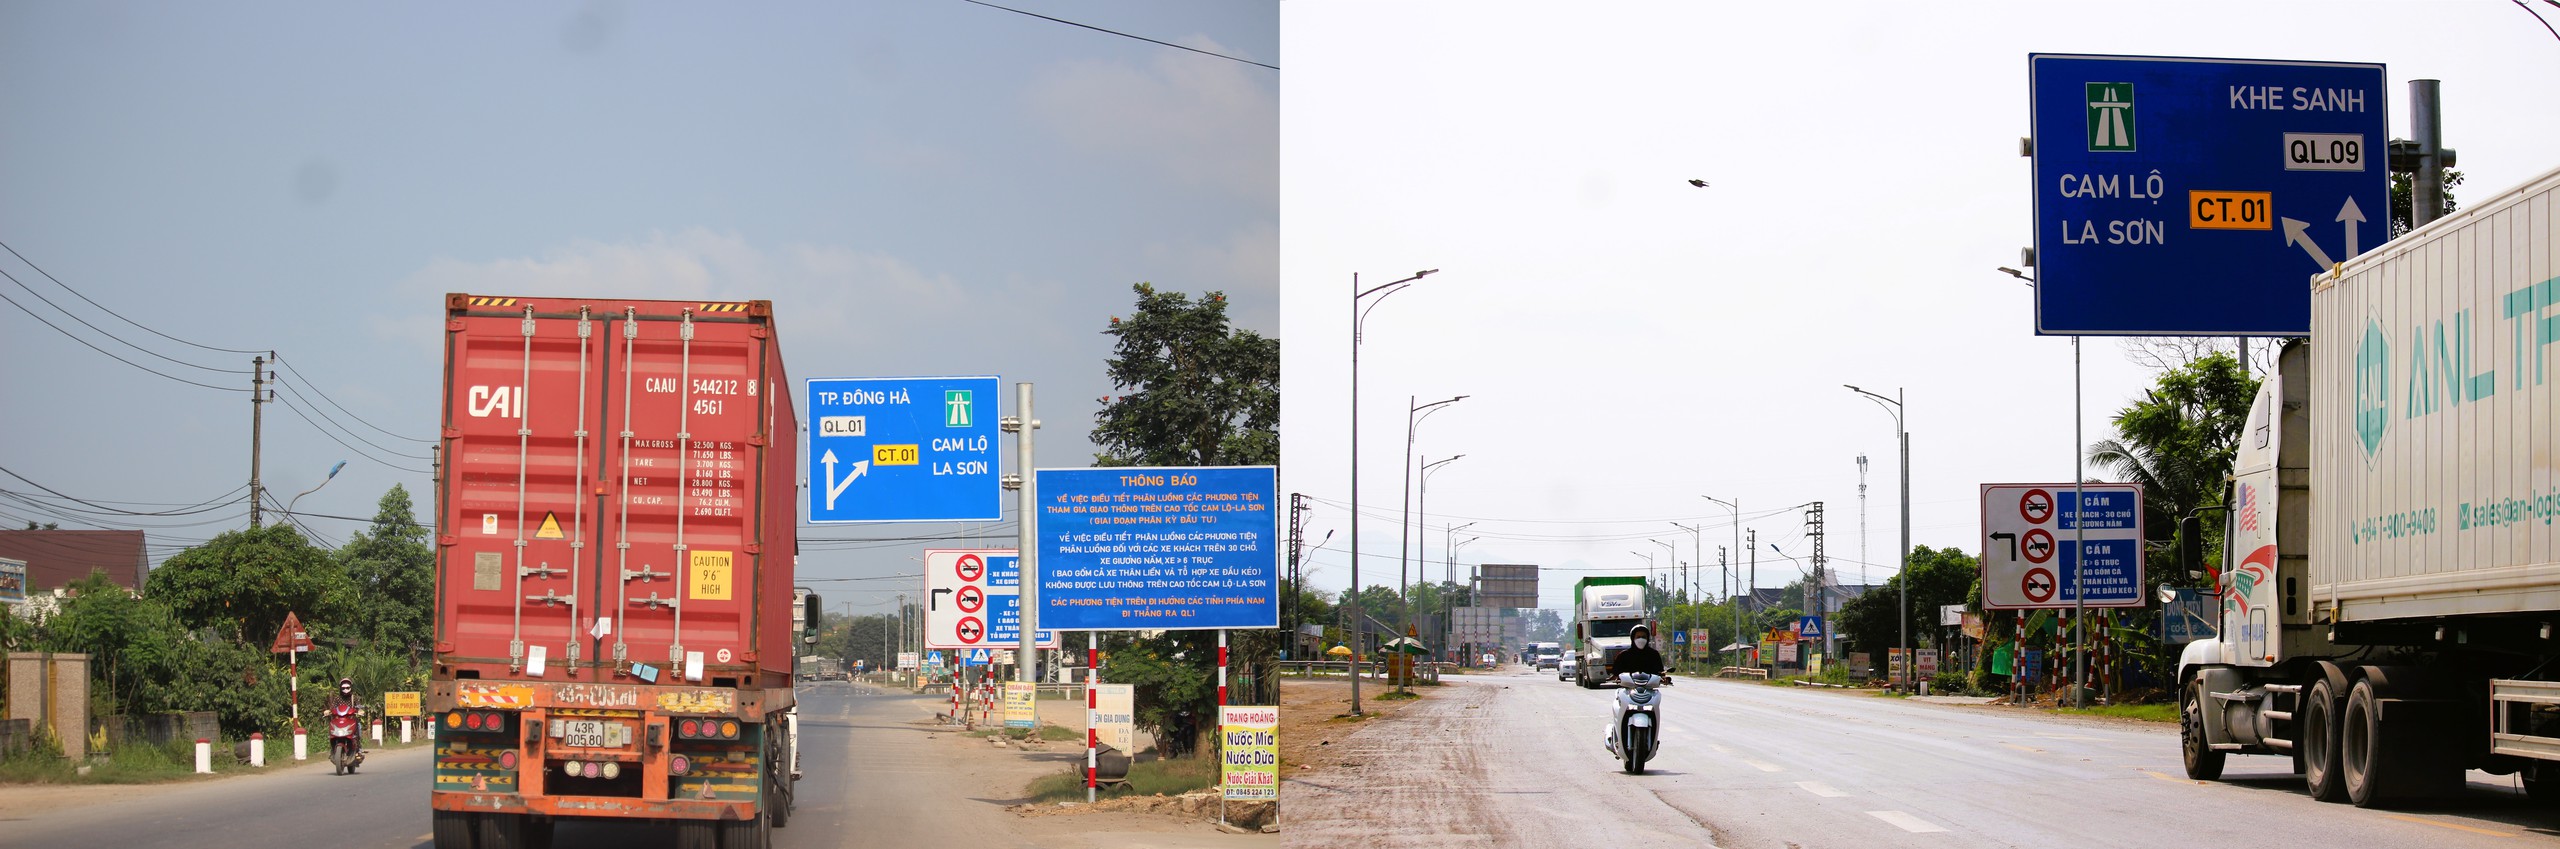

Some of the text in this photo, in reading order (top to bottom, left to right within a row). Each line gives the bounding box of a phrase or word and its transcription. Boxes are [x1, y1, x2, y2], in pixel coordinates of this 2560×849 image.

[2230, 85, 2365, 113] KHE SANH
[2291, 140, 2359, 165] QL.09
[2060, 168, 2164, 205] CAM LỘ
[2197, 198, 2265, 223] CT.01
[2063, 218, 2164, 245] LA SƠN
[2406, 307, 2495, 420] ANL
[645, 377, 738, 395] CAAU 544212
[2358, 362, 2386, 415] ANL
[468, 385, 522, 419] CAI
[819, 387, 911, 405] TP. ĐÔNG HÀ
[693, 399, 722, 415] 45G1
[824, 420, 863, 434] QL.01
[635, 440, 734, 450] MAX GROSS 32.500 KGS.
[932, 435, 988, 454] CAM LỘ
[693, 451, 734, 459] 71.650 LBS.
[877, 449, 915, 462] CT.01
[635, 459, 733, 469] TARE 3.700 KGS.
[933, 460, 988, 475] LA SƠN
[695, 470, 733, 478] 8.160 LBS.
[1120, 472, 1197, 487] THÔNG BÁO
[634, 477, 733, 488] NET 28.800 KGS.
[692, 489, 733, 498] 63.490 LBS.
[1071, 494, 1088, 504] VIỆC
[1133, 494, 1156, 502] PHÂN
[1186, 492, 1203, 501] CÁC
[1205, 493, 1238, 501] PHƯƠNG
[1241, 492, 1259, 502] TIỆN
[647, 497, 663, 505] CAP.
[2084, 494, 2110, 507] CẤM
[694, 508, 712, 516] 2.690
[1090, 505, 1109, 513] GIAO
[1111, 504, 1138, 512] THÔNG
[1140, 503, 1162, 512] TRÊN
[1164, 504, 1180, 512] CAO
[1201, 504, 1219, 512] CAM
[1114, 517, 1136, 526] ĐOẠN
[1139, 516, 1162, 524] PHÂN
[1073, 533, 1091, 543] VIỆC
[1135, 532, 1158, 541] PHÂN
[1188, 531, 1204, 540] CÁC
[1239, 531, 1257, 541] TIỆN
[1060, 544, 1082, 553] PHÂN
[1143, 543, 1158, 552] CÁC
[1173, 542, 1200, 552] KHÁCH
[1203, 543, 1226, 552] TRÊN
[1228, 544, 1238, 552] 30
[2085, 543, 2111, 555] CẤM
[693, 555, 730, 567] CAUTION
[1100, 557, 1110, 565] XE
[1192, 556, 1213, 565] TRỤC
[1106, 569, 1117, 577] XE
[1119, 568, 1141, 576] THÂN
[1209, 568, 1219, 576] XE
[701, 584, 720, 595] HIGH
[1045, 580, 1073, 589] KHÔNG
[1075, 581, 1096, 590] ĐƯỢC
[1099, 581, 1115, 589] LƯU
[1117, 580, 1144, 588] THÔNG
[1146, 579, 1168, 588] TRÊN
[1202, 580, 1220, 588] CAM
[1051, 597, 1067, 606] CÁC
[1069, 598, 1103, 606] PHƯƠNG
[1105, 597, 1123, 607] TIỆN
[1126, 596, 1147, 605] TRÊN
[1187, 595, 1203, 605] CÁC
[1226, 595, 1244, 604] PHÍA
[1104, 714, 1113, 723] GIA
[1227, 710, 1274, 723] TRANG HOÀNG
[574, 722, 595, 734] 43R
[567, 734, 601, 746] 005.80
[1227, 730, 1274, 746] Nước Mía
[1226, 749, 1274, 765] Nước Dừa
[1227, 771, 1273, 785] Nước Giải Khát
